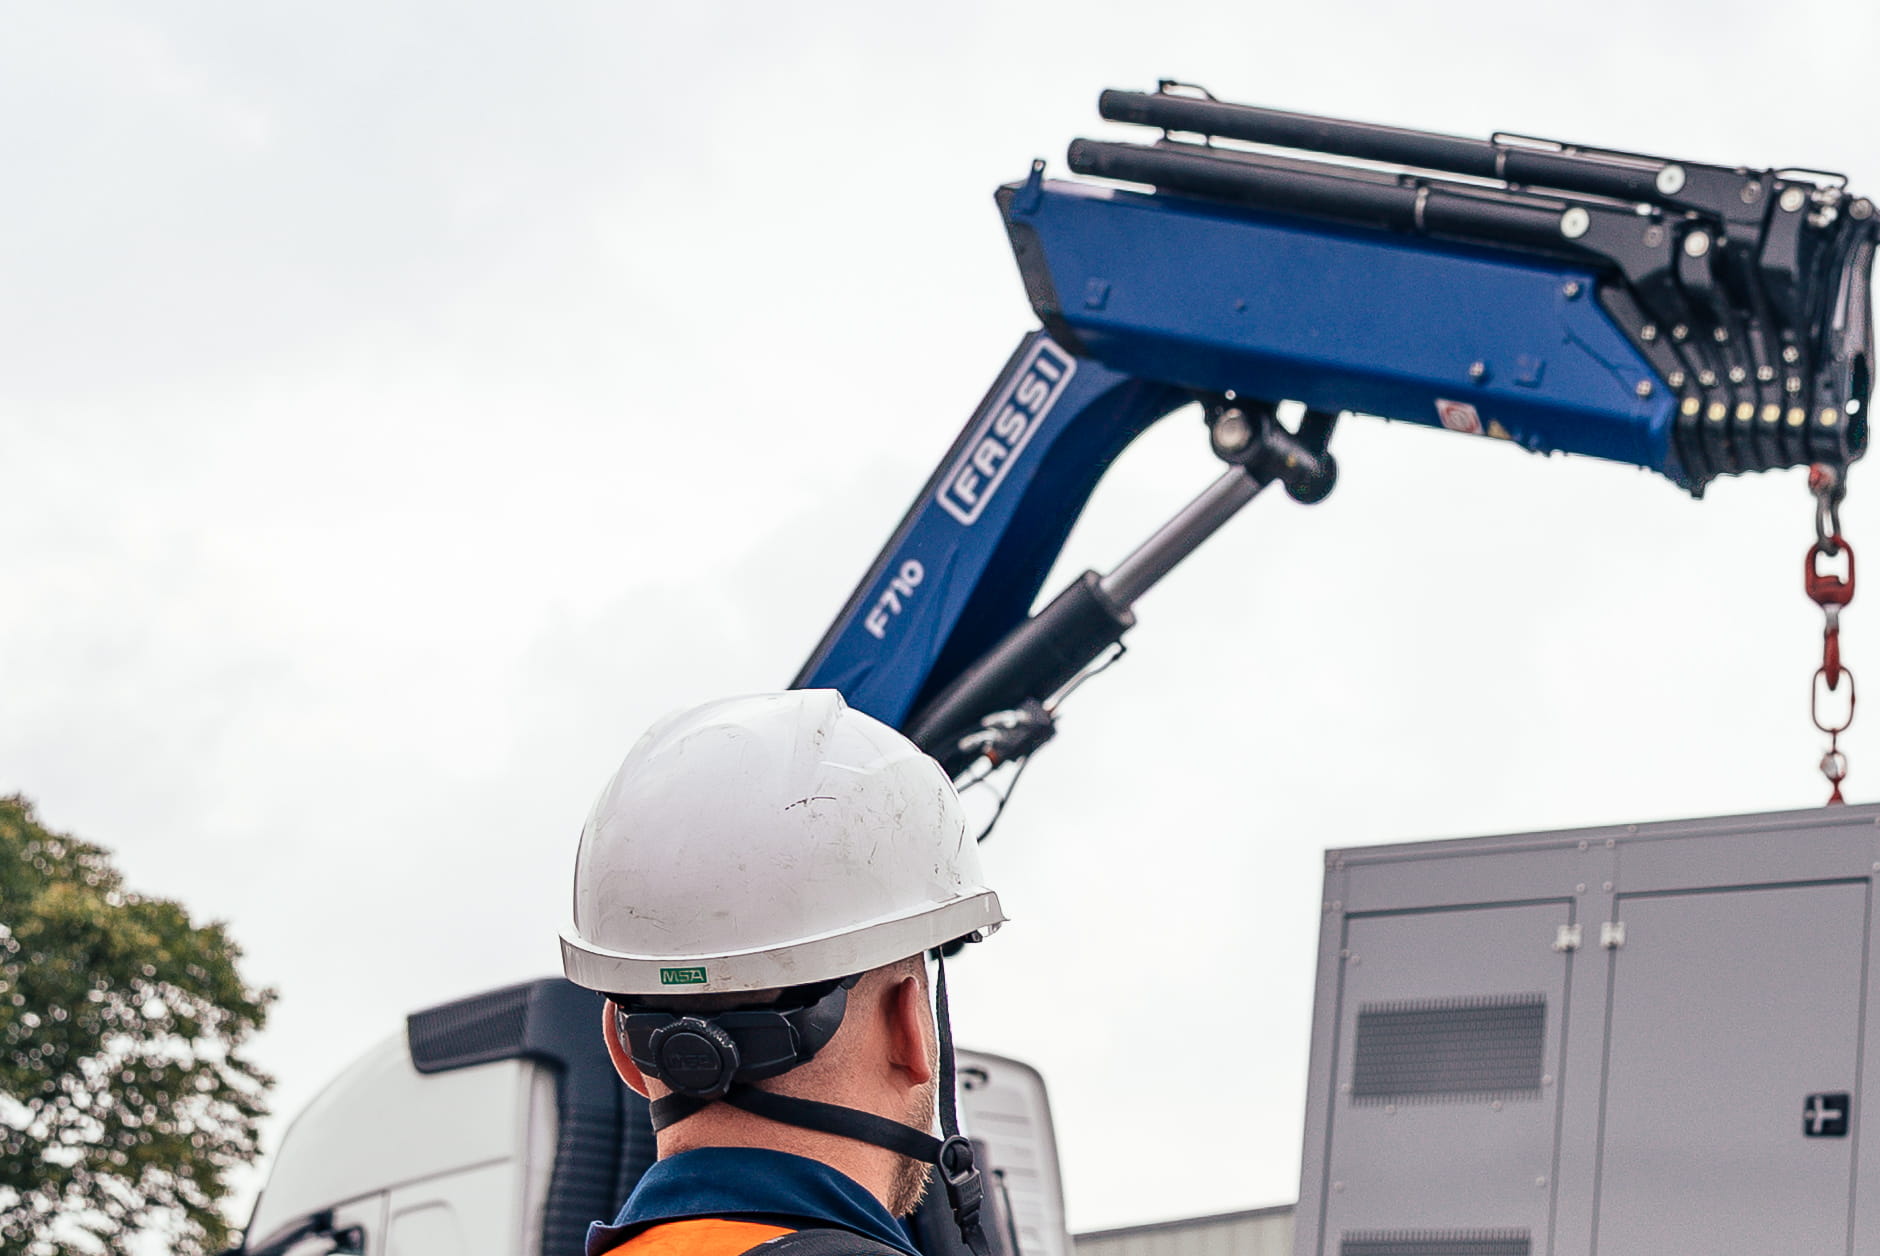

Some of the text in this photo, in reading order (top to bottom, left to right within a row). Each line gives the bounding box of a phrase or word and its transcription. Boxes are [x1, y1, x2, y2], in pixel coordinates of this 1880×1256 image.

[955, 356, 1061, 507] FASSI
[865, 559, 925, 640] F710
[662, 970, 705, 983] MSA
